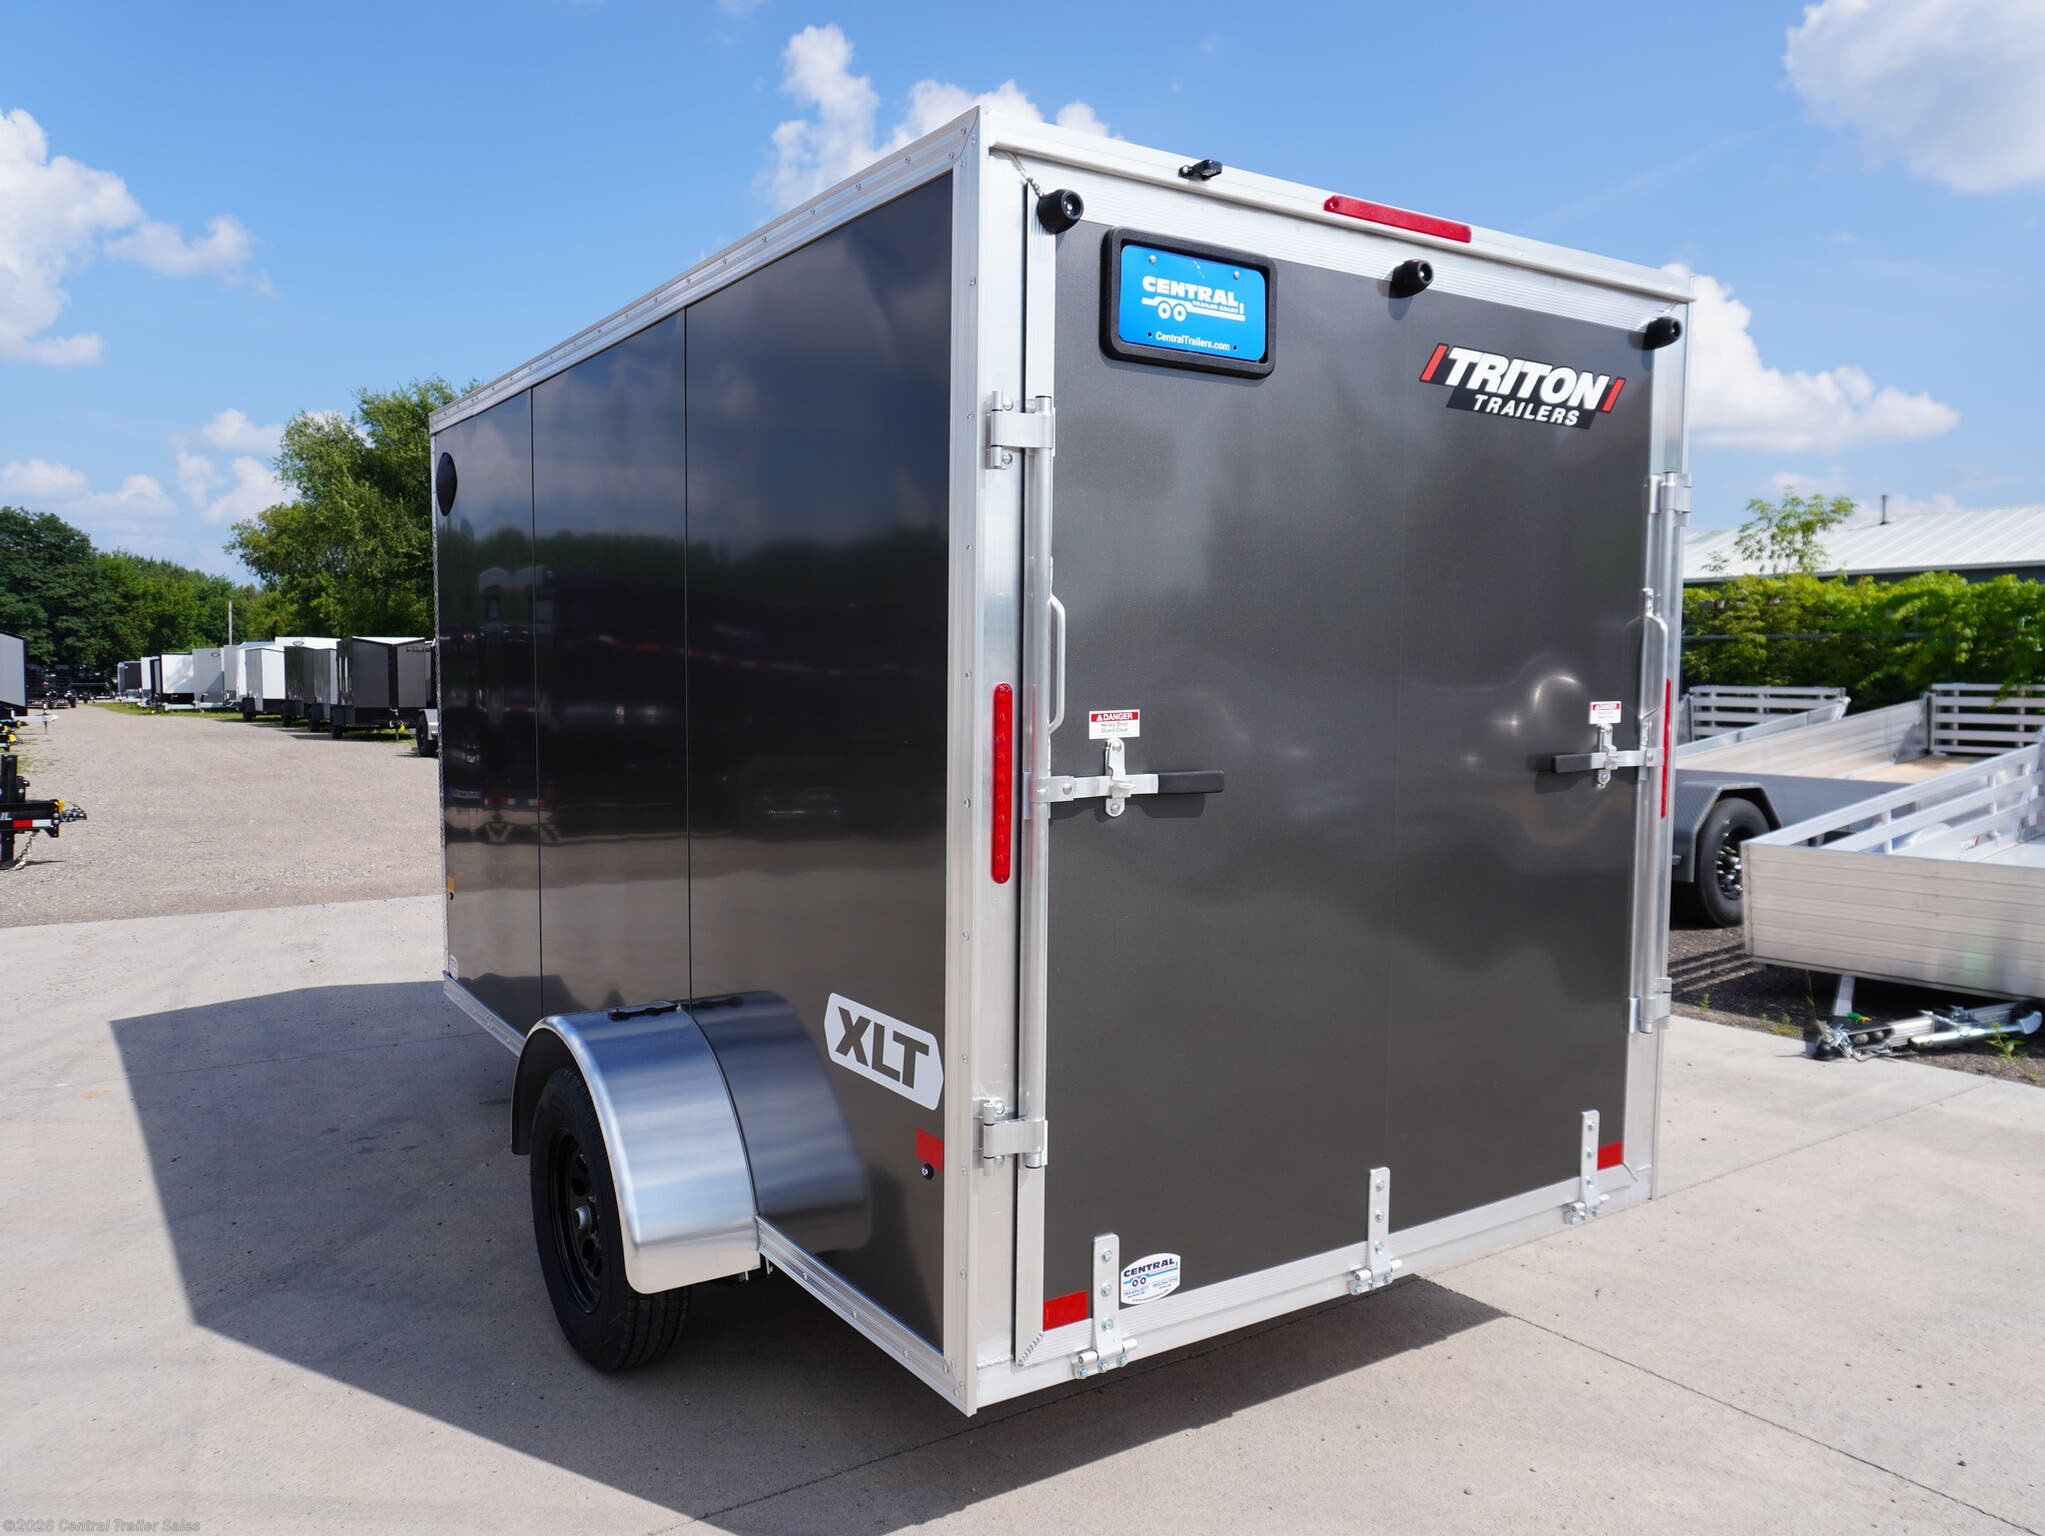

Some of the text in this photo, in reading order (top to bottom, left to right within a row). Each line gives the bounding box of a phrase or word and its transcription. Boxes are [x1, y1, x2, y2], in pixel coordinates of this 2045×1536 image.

[1142, 275, 1239, 307] CENTRAL
[1155, 331, 1230, 351] CentralTrailers.com
[1445, 347, 1610, 411] TRITON
[1473, 394, 1580, 426] TRAILERS
[1103, 712, 1133, 721] DANGER
[835, 1006, 930, 1090] XLT
[1123, 1258, 1175, 1278] CENTRAL
